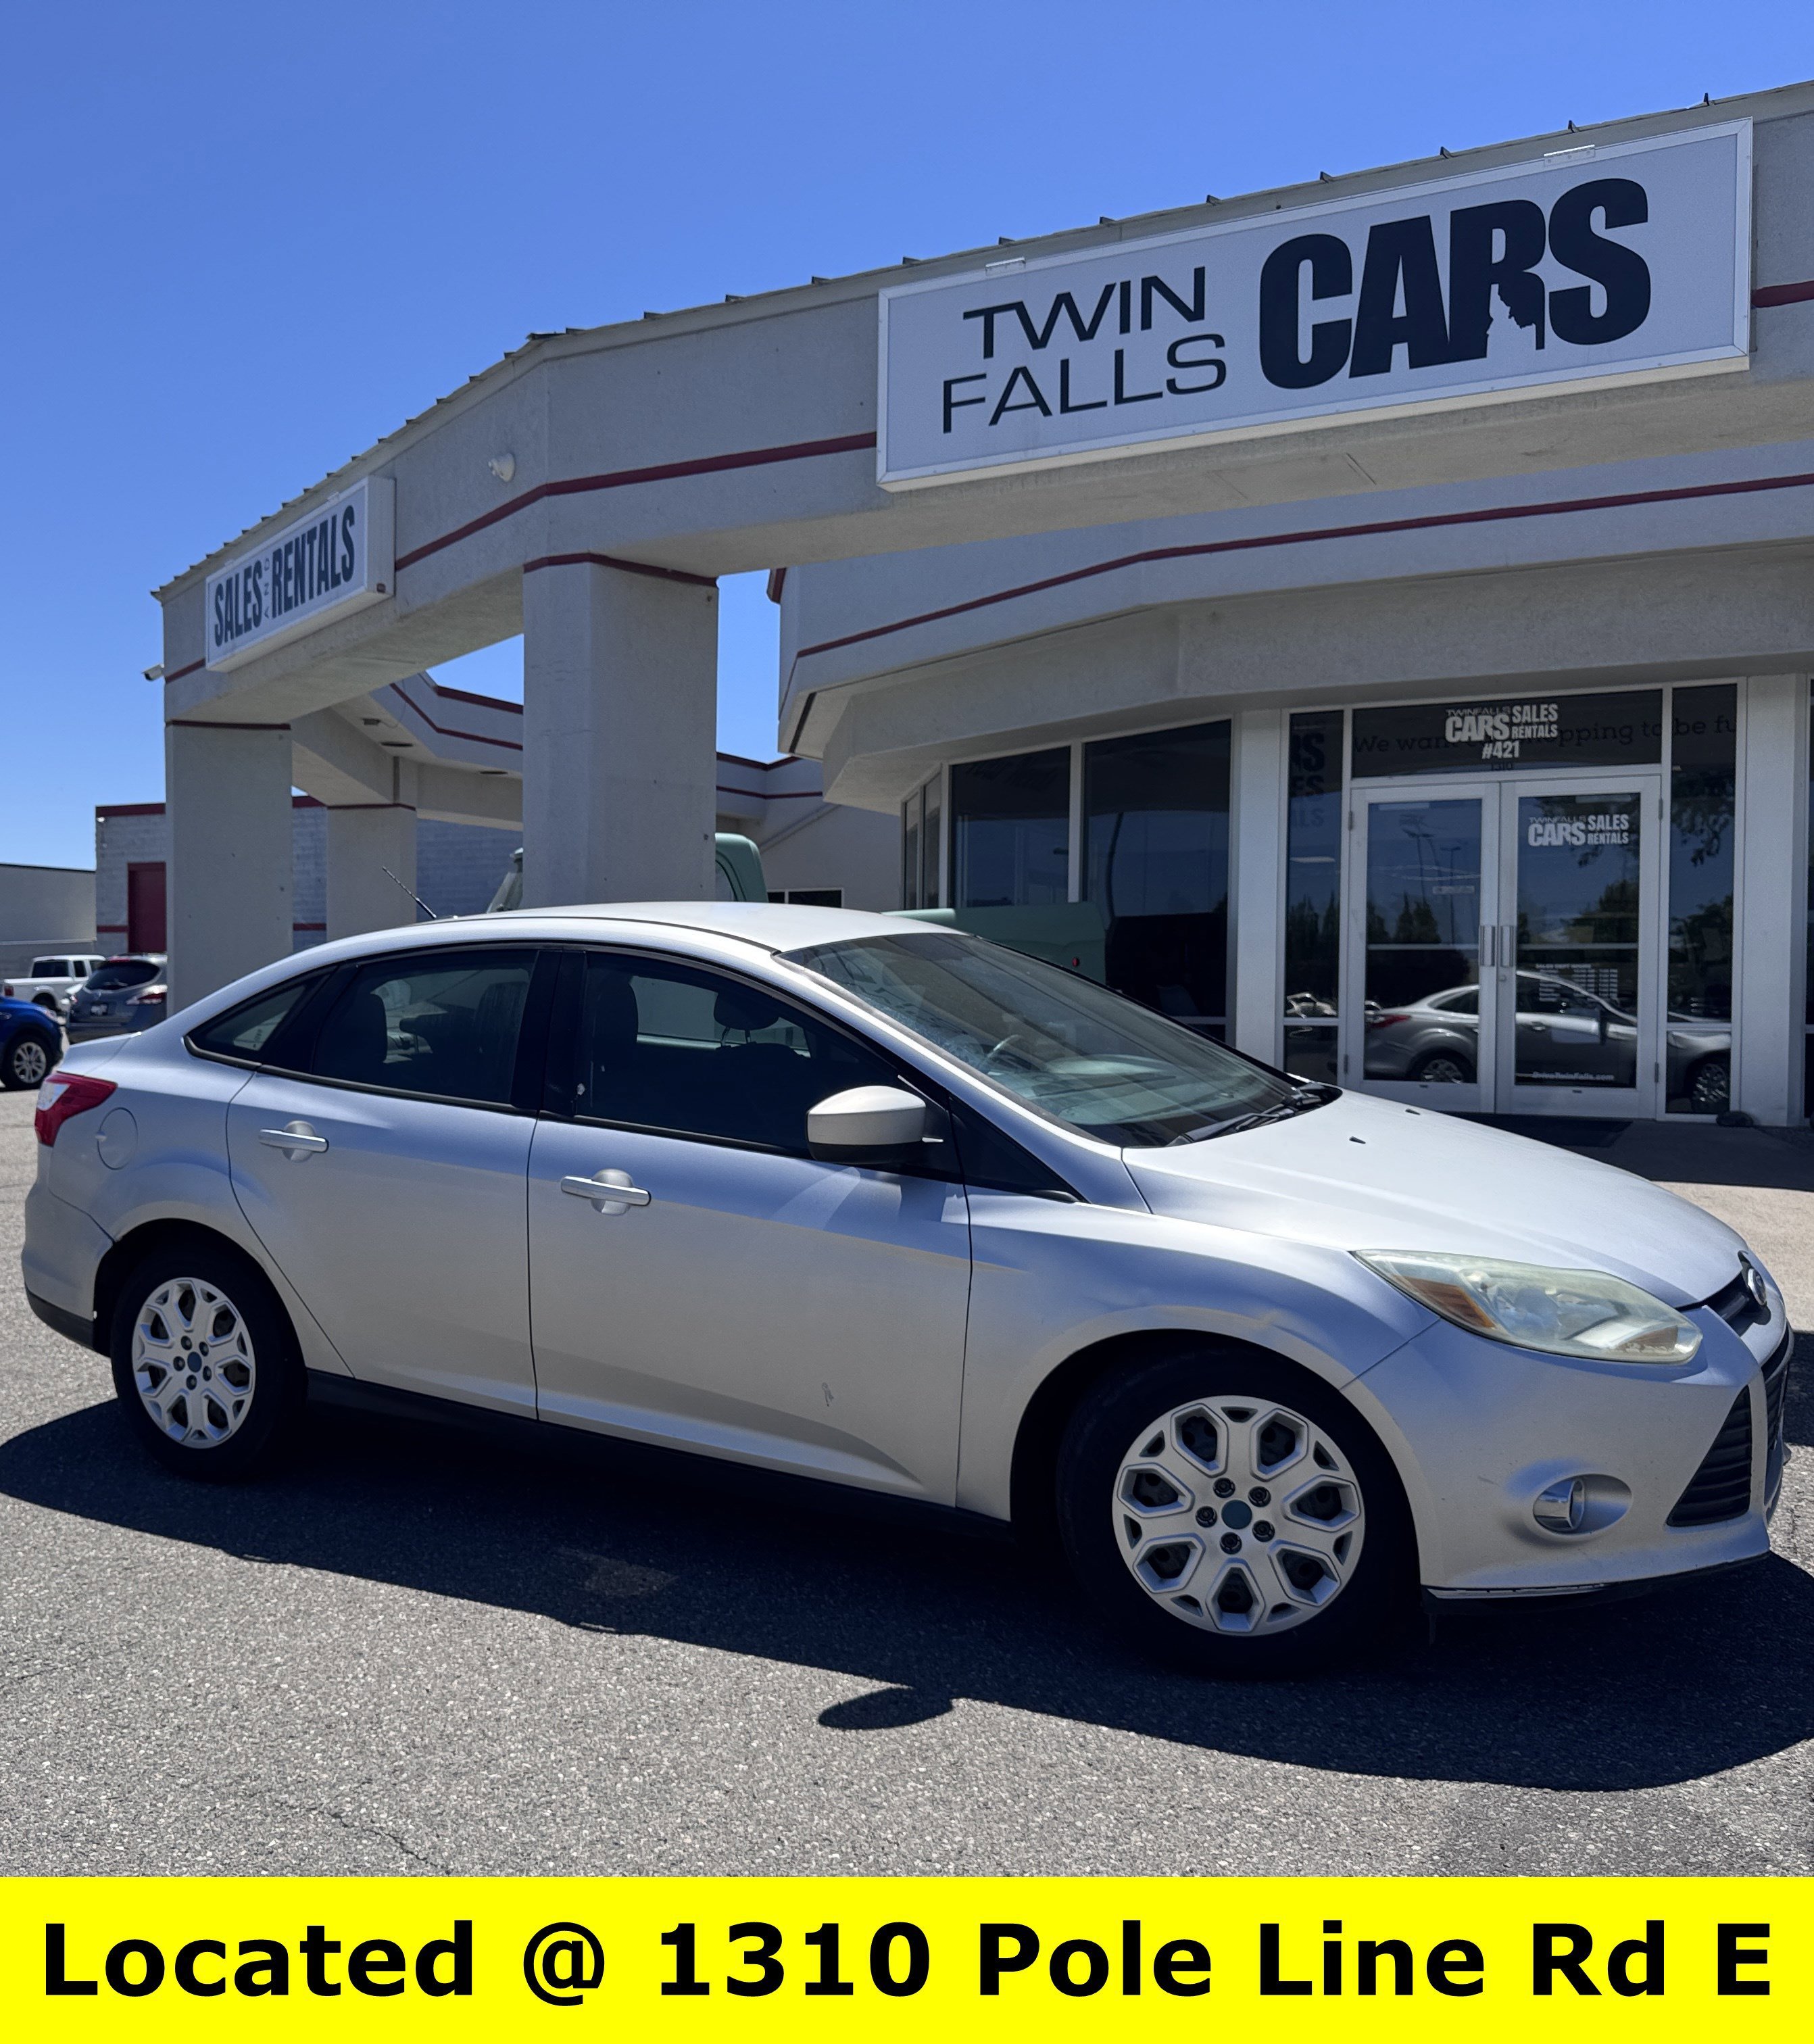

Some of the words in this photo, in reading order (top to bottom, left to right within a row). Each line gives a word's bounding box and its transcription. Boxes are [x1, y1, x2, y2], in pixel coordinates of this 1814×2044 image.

[1260, 178, 1650, 389] CARS
[963, 266, 1205, 359] TWIN
[943, 334, 1226, 433] FALLS
[272, 505, 355, 618] RENTALS
[215, 560, 262, 647] SALES
[1512, 704, 1559, 723] SALES
[1354, 735, 1390, 752] We
[1673, 717, 1706, 735] be
[1445, 714, 1511, 743] CARS
[1512, 723, 1559, 739] RENTALS
[1481, 740, 1520, 759] #421
[1528, 821, 1586, 846] CARS
[1588, 814, 1629, 831] SALES
[1587, 831, 1629, 846] RENTALS
